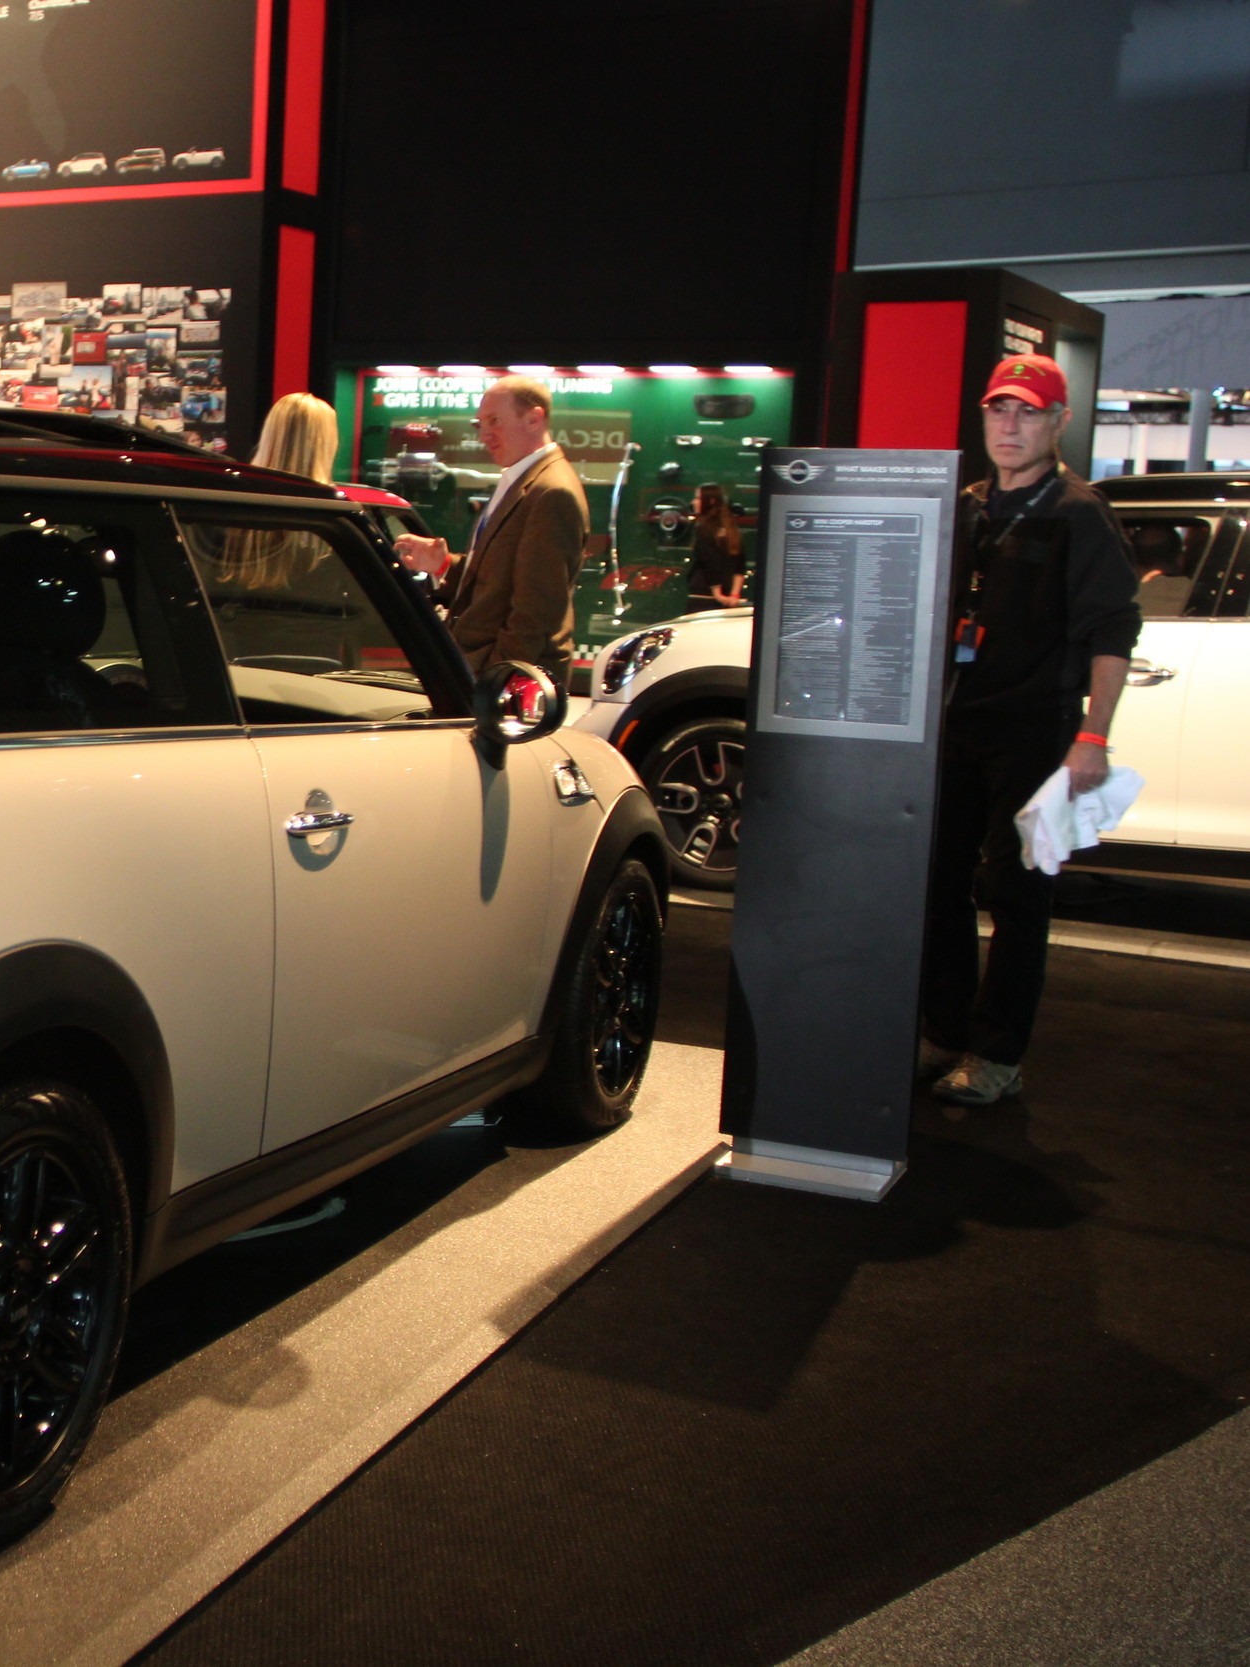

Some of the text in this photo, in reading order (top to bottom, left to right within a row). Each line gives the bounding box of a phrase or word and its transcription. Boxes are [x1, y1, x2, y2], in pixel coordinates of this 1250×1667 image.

[373, 377, 419, 394] JOHN
[419, 377, 484, 394] COOPER
[552, 377, 613, 394] TUNING
[383, 393, 420, 408] GIVE
[437, 393, 469, 408] THE
[835, 465, 948, 475] WHAT MAKES YOURS UNIQUE
